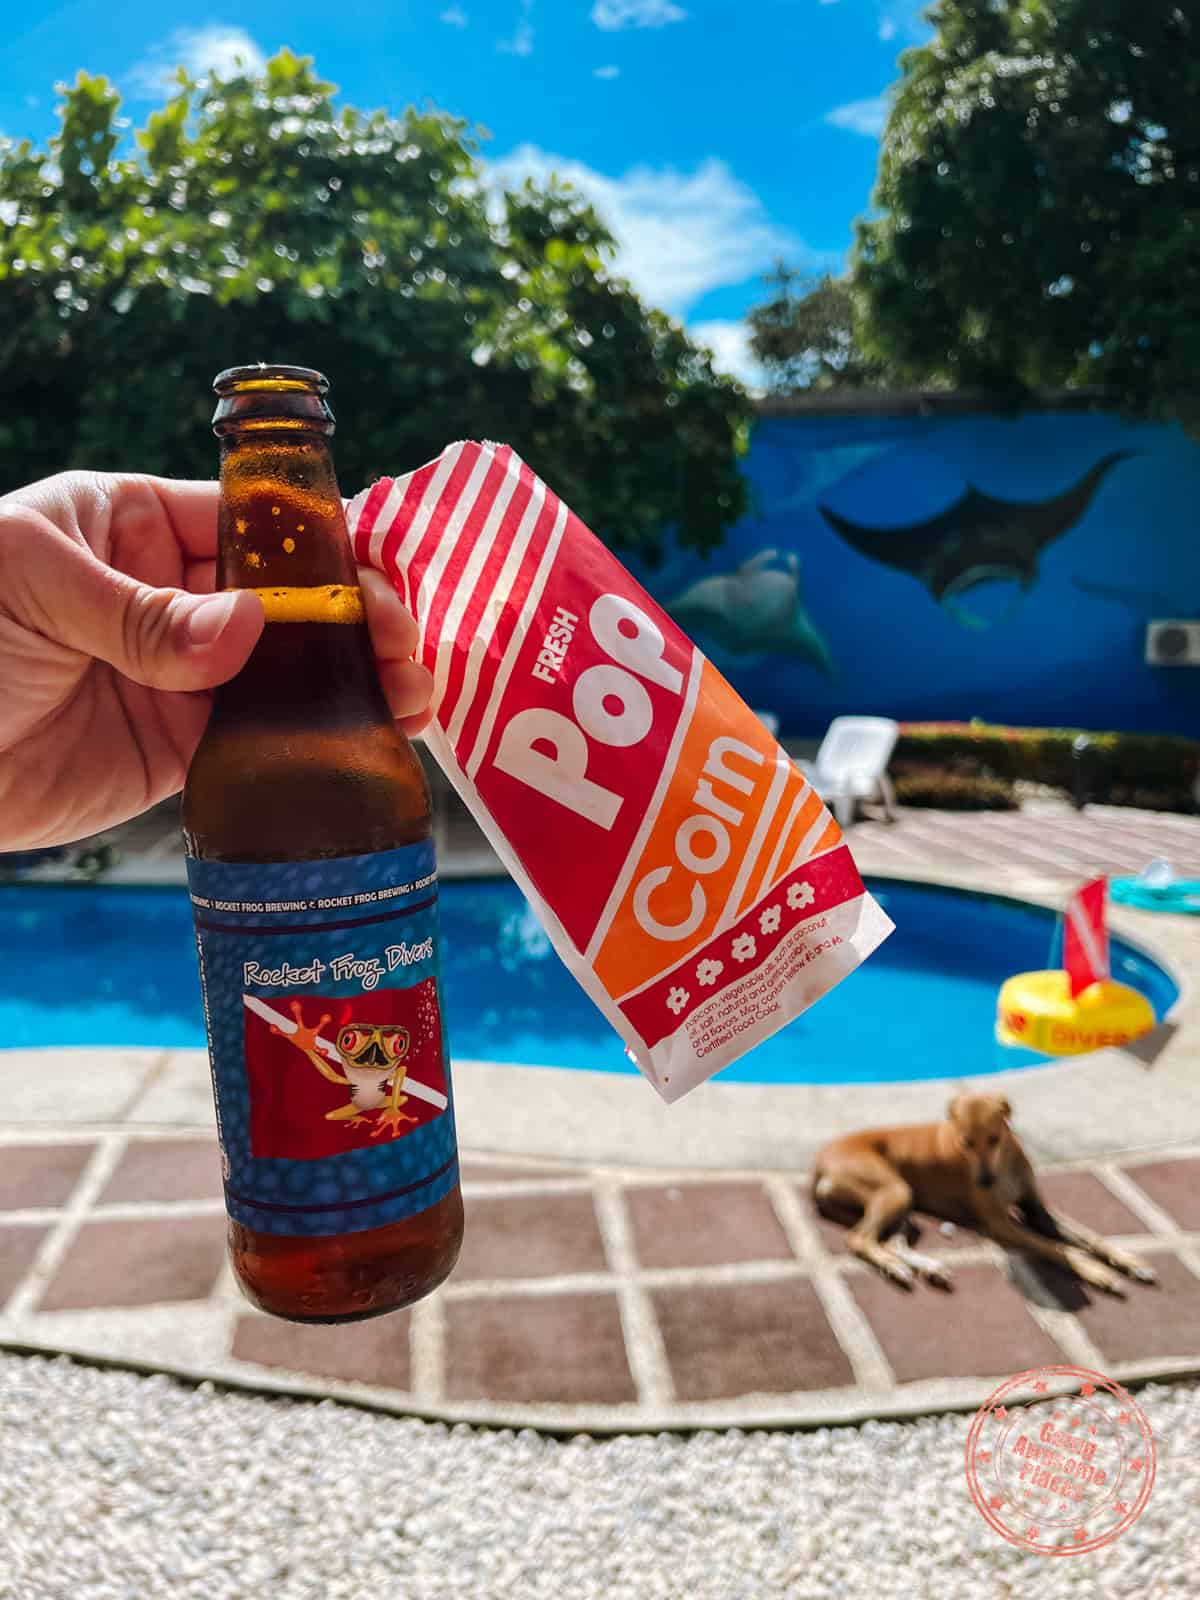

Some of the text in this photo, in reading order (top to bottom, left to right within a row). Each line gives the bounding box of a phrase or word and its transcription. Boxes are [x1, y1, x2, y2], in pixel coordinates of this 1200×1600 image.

[531, 606, 579, 685] FRESH
[492, 593, 683, 832] Pop
[633, 736, 765, 941] Corn
[215, 900, 240, 912] ROCKET
[242, 902, 264, 913] FROG
[265, 901, 308, 913] BREWING
[317, 895, 353, 909] ROCKET
[354, 891, 377, 905] FROG
[378, 884, 410, 900] BREWING
[243, 958, 327, 987] Rocket
[329, 953, 386, 990] Frog
[748, 983, 768, 1000] and
[738, 1001, 761, 1018] May
[695, 1029, 734, 1059] Certified
[732, 1016, 756, 1036] Food
